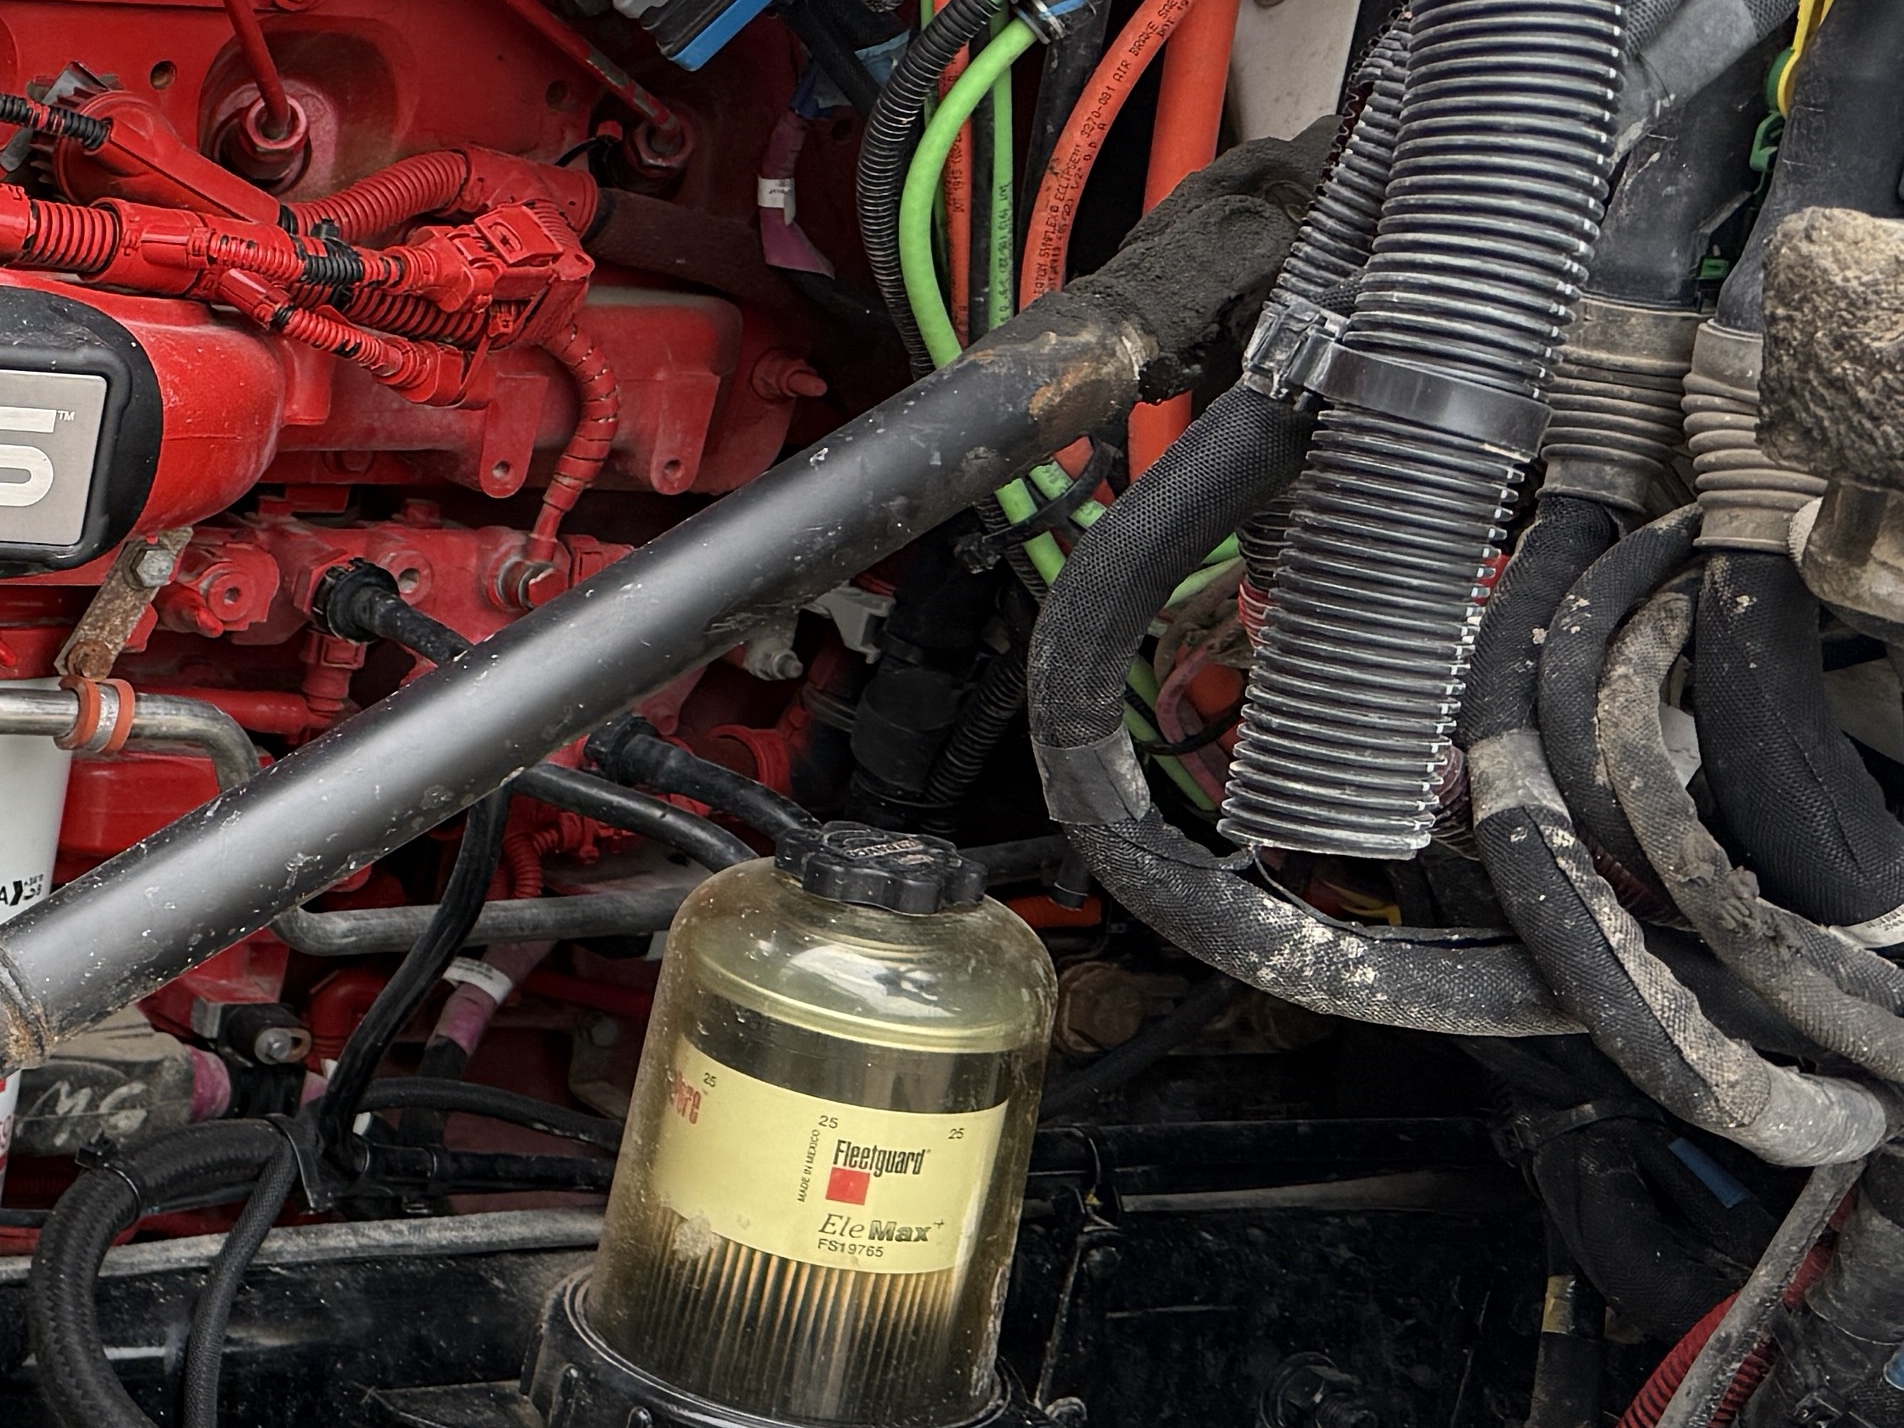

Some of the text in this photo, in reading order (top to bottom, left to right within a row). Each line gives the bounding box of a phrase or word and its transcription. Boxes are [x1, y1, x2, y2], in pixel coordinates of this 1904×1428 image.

[1112, 58, 1132, 83] AIR
[703, 1072, 717, 1088] 25
[818, 1114, 839, 1130] 25
[948, 1127, 965, 1140] 25
[797, 1174, 811, 1203] MADE
[807, 1129, 821, 1162] MEXICO
[832, 1139, 927, 1178] Fleetguard
[817, 1239, 884, 1258] FS19765
